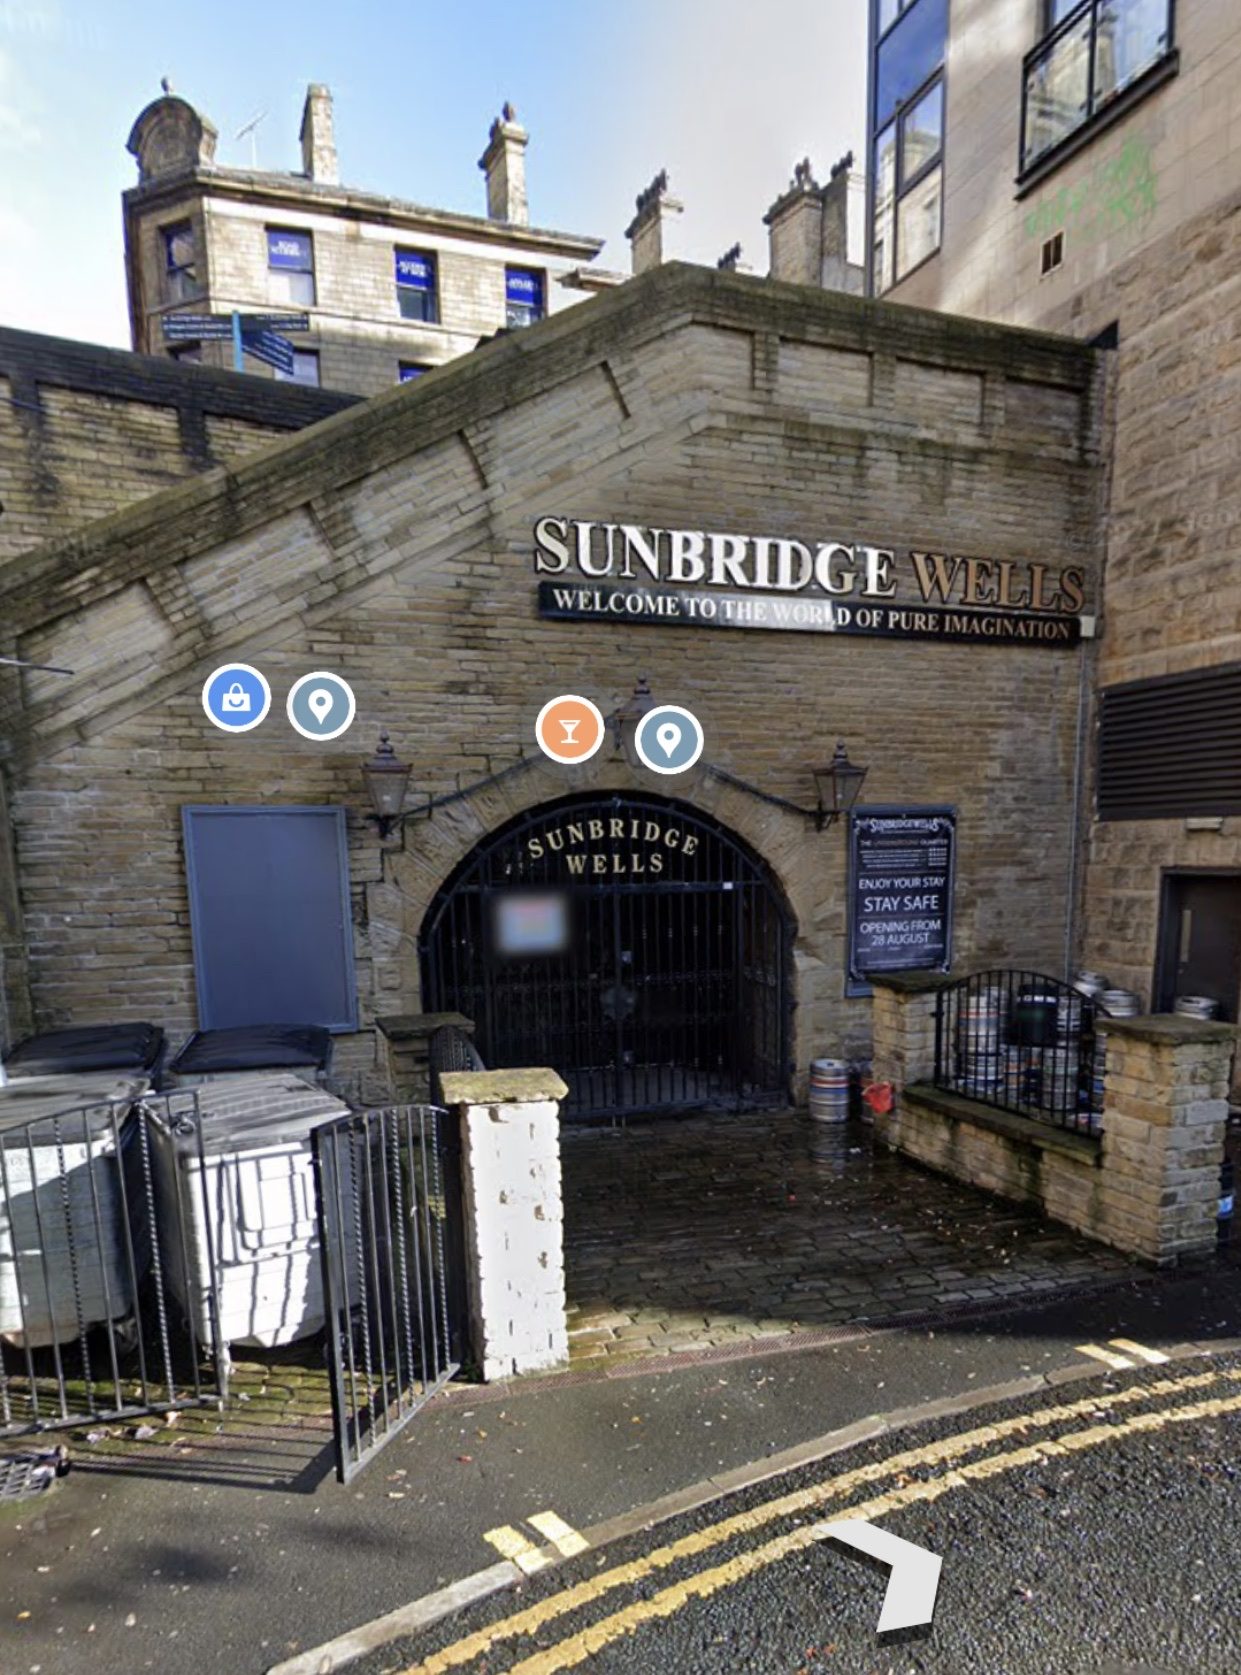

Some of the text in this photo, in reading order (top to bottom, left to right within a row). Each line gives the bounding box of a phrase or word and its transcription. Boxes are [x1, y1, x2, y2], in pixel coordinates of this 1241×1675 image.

[534, 516, 1086, 613] SUNBRIDGE WELLS
[553, 588, 1072, 639] WELCOME TO THE WORLD OF PURE IMAGINATION
[527, 817, 700, 859] SUNBRIDGE
[565, 853, 664, 874] WELLS
[858, 875, 946, 890] ENJOY YOUR STAY
[863, 894, 940, 913] STAY SAFE
[859, 918, 942, 935] OPENING FROM
[871, 931, 930, 947] 28 AUGUST
